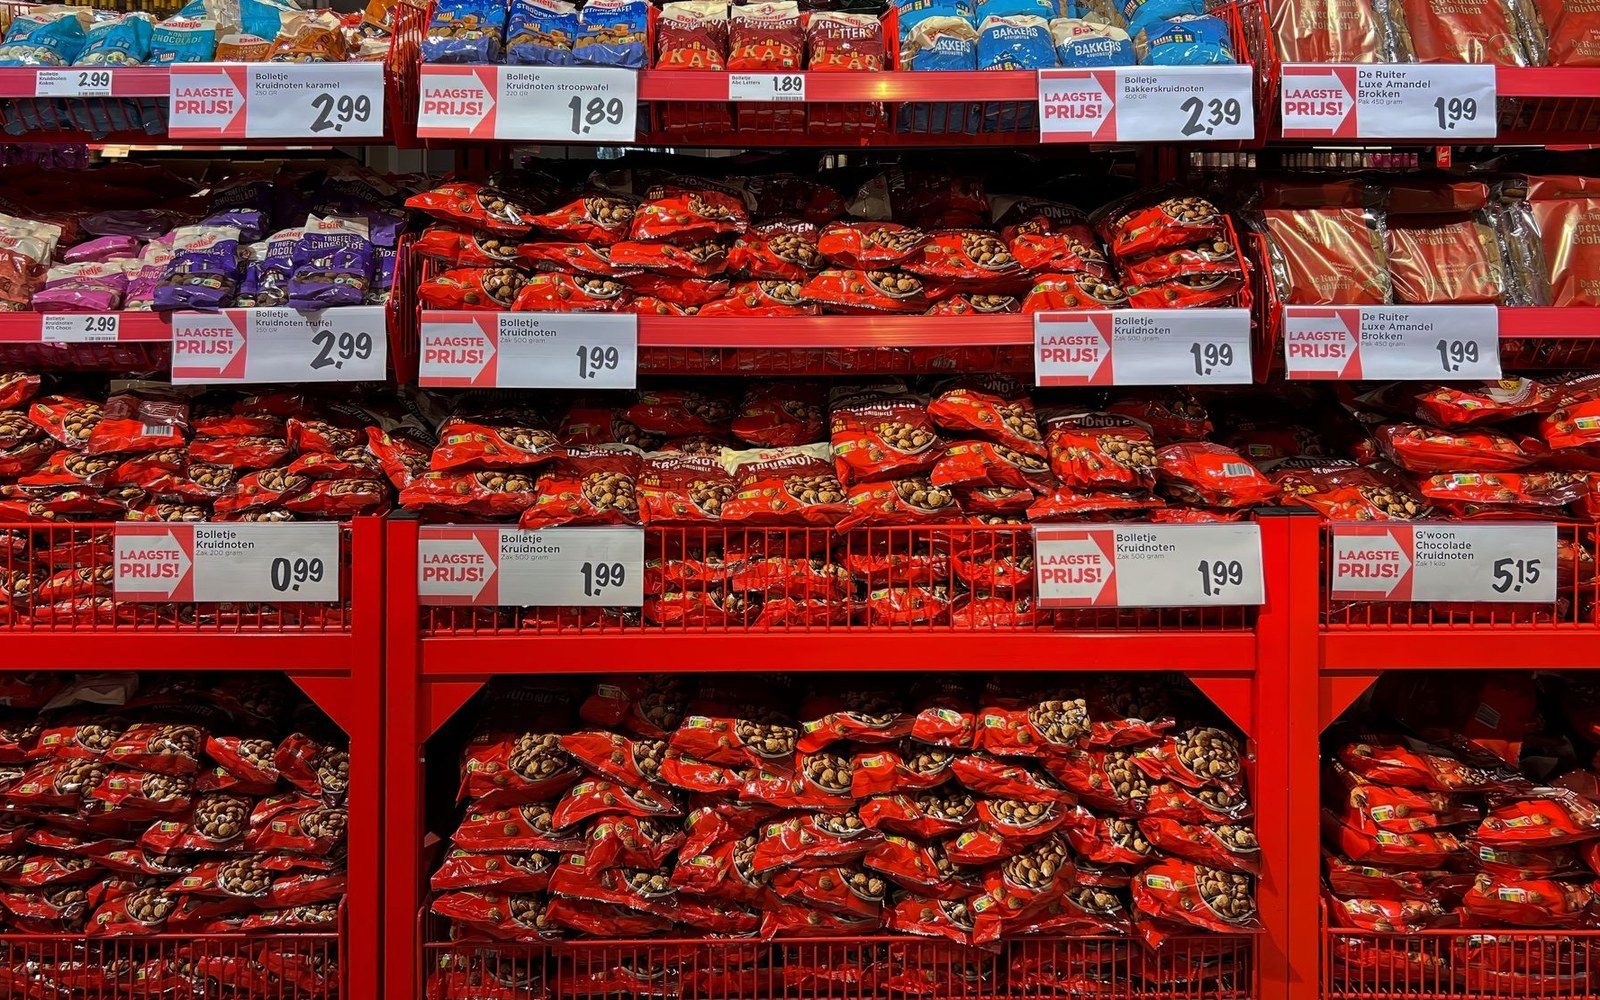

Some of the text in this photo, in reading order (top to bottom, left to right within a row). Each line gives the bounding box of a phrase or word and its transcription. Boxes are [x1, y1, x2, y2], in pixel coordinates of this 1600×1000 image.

[993, 27, 1039, 39] BAKKERS
[1075, 40, 1121, 56] BAKKERS
[78, 71, 110, 87] 2.99
[255, 73, 288, 81] Bolletje
[506, 73, 540, 82] Bolletje
[1358, 70, 1406, 79] De Ruiter
[305, 81, 340, 89] karamel
[773, 76, 802, 91] 1.89
[1124, 76, 1157, 85] Bolletje
[1358, 80, 1431, 89] Luxe Amandel
[506, 82, 609, 93] Kruidnoten stroopwafel
[1124, 84, 1204, 93] Bakkerskruidnoten
[176, 88, 233, 98] LAAGSTE
[425, 89, 484, 99] LAAGSTE
[1044, 93, 1102, 102] LAAGSTE
[1285, 89, 1343, 99] LAAGSTE
[1358, 89, 1400, 98] Brokken
[175, 100, 233, 114] PRIJS!
[424, 101, 483, 116] PRIJS!
[1044, 104, 1102, 119] PRIJS!
[1285, 101, 1343, 116] PRIJS!
[310, 92, 371, 133] 2.99
[568, 95, 624, 135] 1.89
[1180, 96, 1241, 136] 2.39
[1434, 96, 1477, 130] 1.99
[256, 310, 289, 319] Bolletje
[1362, 313, 1409, 322] De Ruiter
[85, 316, 116, 332] 2.99
[256, 319, 332, 327] Kruidnoten truffel
[500, 319, 539, 328] Bolletje
[1114, 317, 1154, 326] Bolletje
[1361, 322, 1433, 331] Luxe Amandel
[176, 328, 233, 337] LAAGSTE
[500, 328, 557, 337] Kruidnoten
[1114, 326, 1171, 335] Kruidnoten
[1041, 336, 1099, 345] LAAGSTE
[1289, 331, 1346, 341] LAAGSTE
[1361, 332, 1403, 340] Brokken
[425, 337, 484, 347] LAAGSTE
[176, 340, 233, 355] PRIJS!
[310, 330, 373, 370] 2.99
[1289, 344, 1346, 358] PRIJS!
[425, 349, 484, 364] PRIJS!
[1040, 348, 1099, 363] PRIJS!
[1190, 342, 1234, 376] 1.99
[1436, 339, 1479, 372] 1.99
[576, 345, 619, 379] 1.99
[196, 530, 237, 540] Bolletje
[501, 534, 542, 544] Bolletje
[1116, 533, 1157, 543] Bolletje
[1416, 531, 1455, 540] G'woon
[196, 540, 254, 549] Kruidnoten
[501, 544, 560, 553] Kruidnoten
[1116, 543, 1176, 552] Kruidnoten
[1416, 541, 1472, 550] Chocolade
[120, 550, 180, 560] LAAGSTE
[423, 554, 484, 564] LAAGSTE
[1040, 555, 1101, 564] LAAGSTE
[1339, 550, 1400, 560] LAAGSTE
[1416, 551, 1474, 560] Kruidnoten
[120, 563, 180, 578] PRIJS!
[271, 557, 324, 592] 0.99
[423, 567, 484, 582] PRIJS!
[1338, 563, 1399, 578] PRIJS!
[1492, 558, 1541, 593] 5.15
[580, 562, 625, 597] 1.99
[1041, 568, 1102, 584] PRIJS!
[1198, 560, 1243, 596] 1.99
